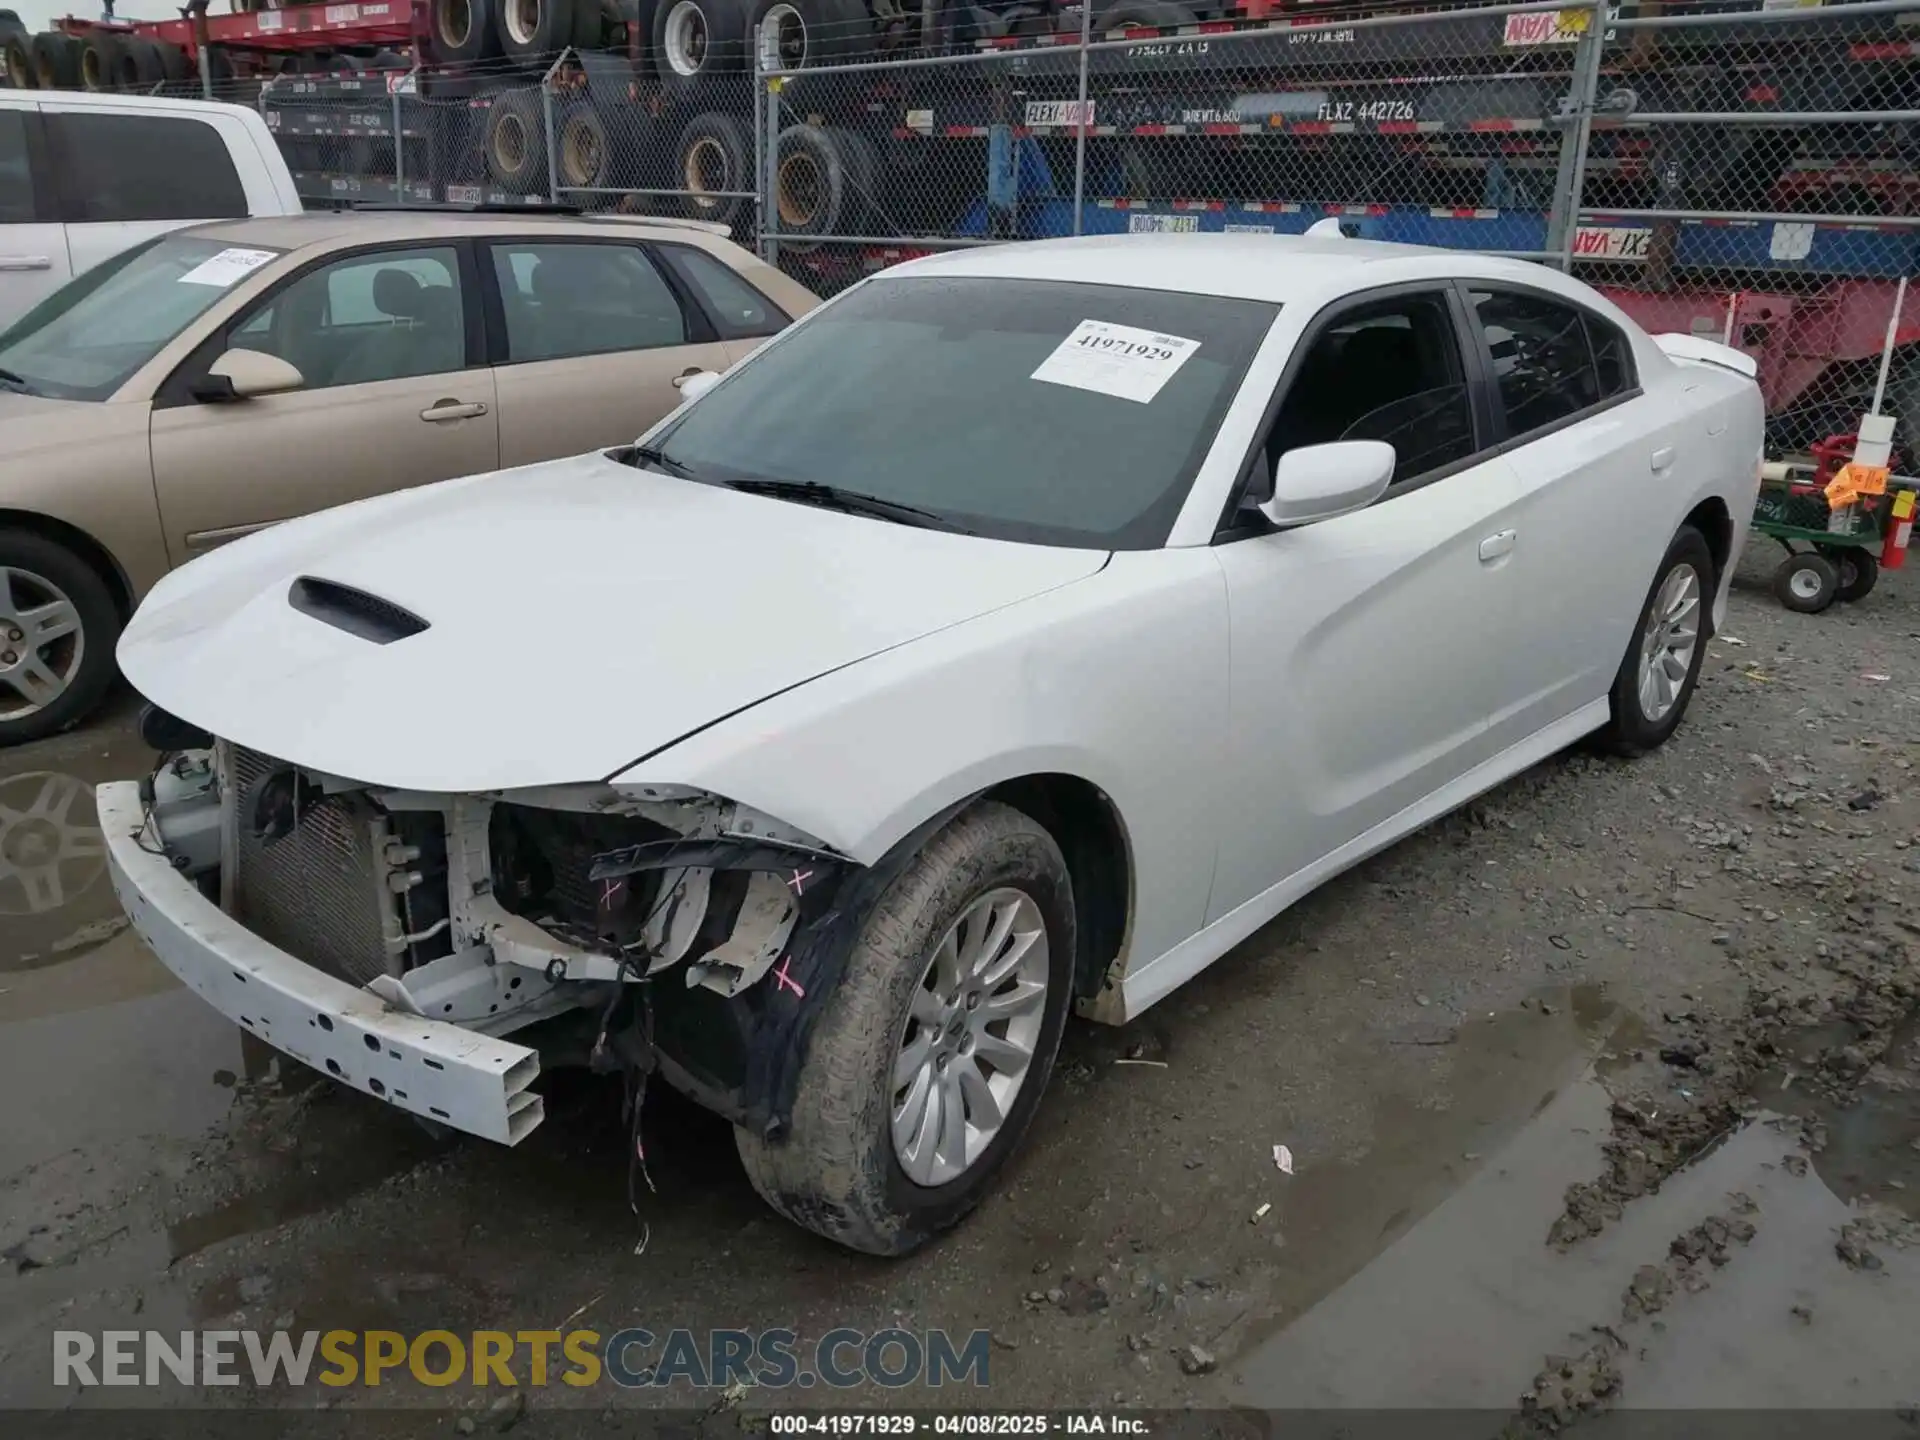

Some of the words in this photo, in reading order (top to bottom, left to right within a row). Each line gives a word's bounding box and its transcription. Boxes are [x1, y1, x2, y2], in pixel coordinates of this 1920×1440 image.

[1318, 102, 1353, 120] FLXZ
[1360, 101, 1414, 120] 442726
[1077, 335, 1173, 361] 41971929
